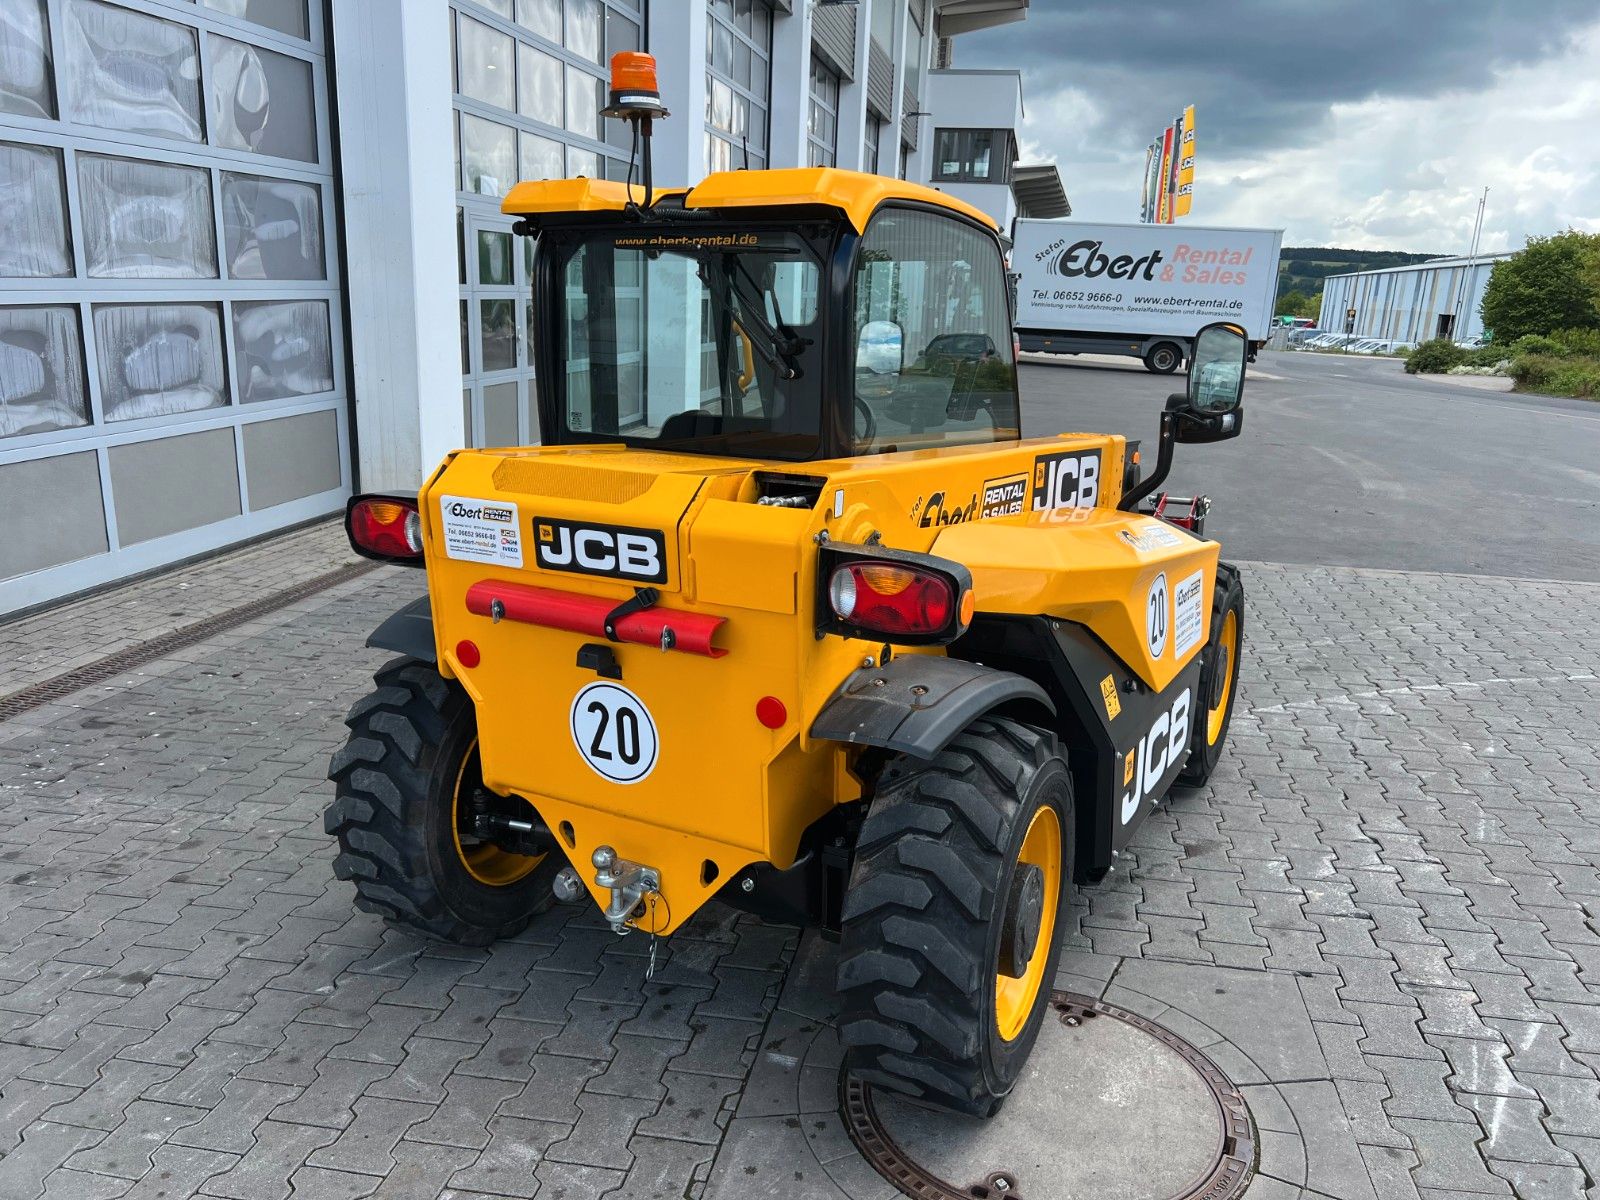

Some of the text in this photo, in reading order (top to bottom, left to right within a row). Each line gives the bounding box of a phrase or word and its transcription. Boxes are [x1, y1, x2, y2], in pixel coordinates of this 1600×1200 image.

[615, 234, 758, 246] wwwebert-rental.de
[1035, 239, 1065, 262] Stefan
[1059, 240, 1164, 281] Ebert
[1171, 244, 1253, 265] Rental
[1160, 264, 1247, 285] & Sales
[1033, 289, 1122, 303] Tel. 06652 9666-0
[1134, 296, 1243, 309] www.ebert-rental.de
[983, 483, 1025, 506] RENTAL
[1033, 455, 1098, 512] JCB
[451, 502, 482, 520] Ebert
[991, 500, 1023, 518] SALES
[540, 527, 661, 577] JCB
[1150, 587, 1165, 646] 20
[587, 701, 641, 766] 20
[1121, 687, 1191, 826] JCB
